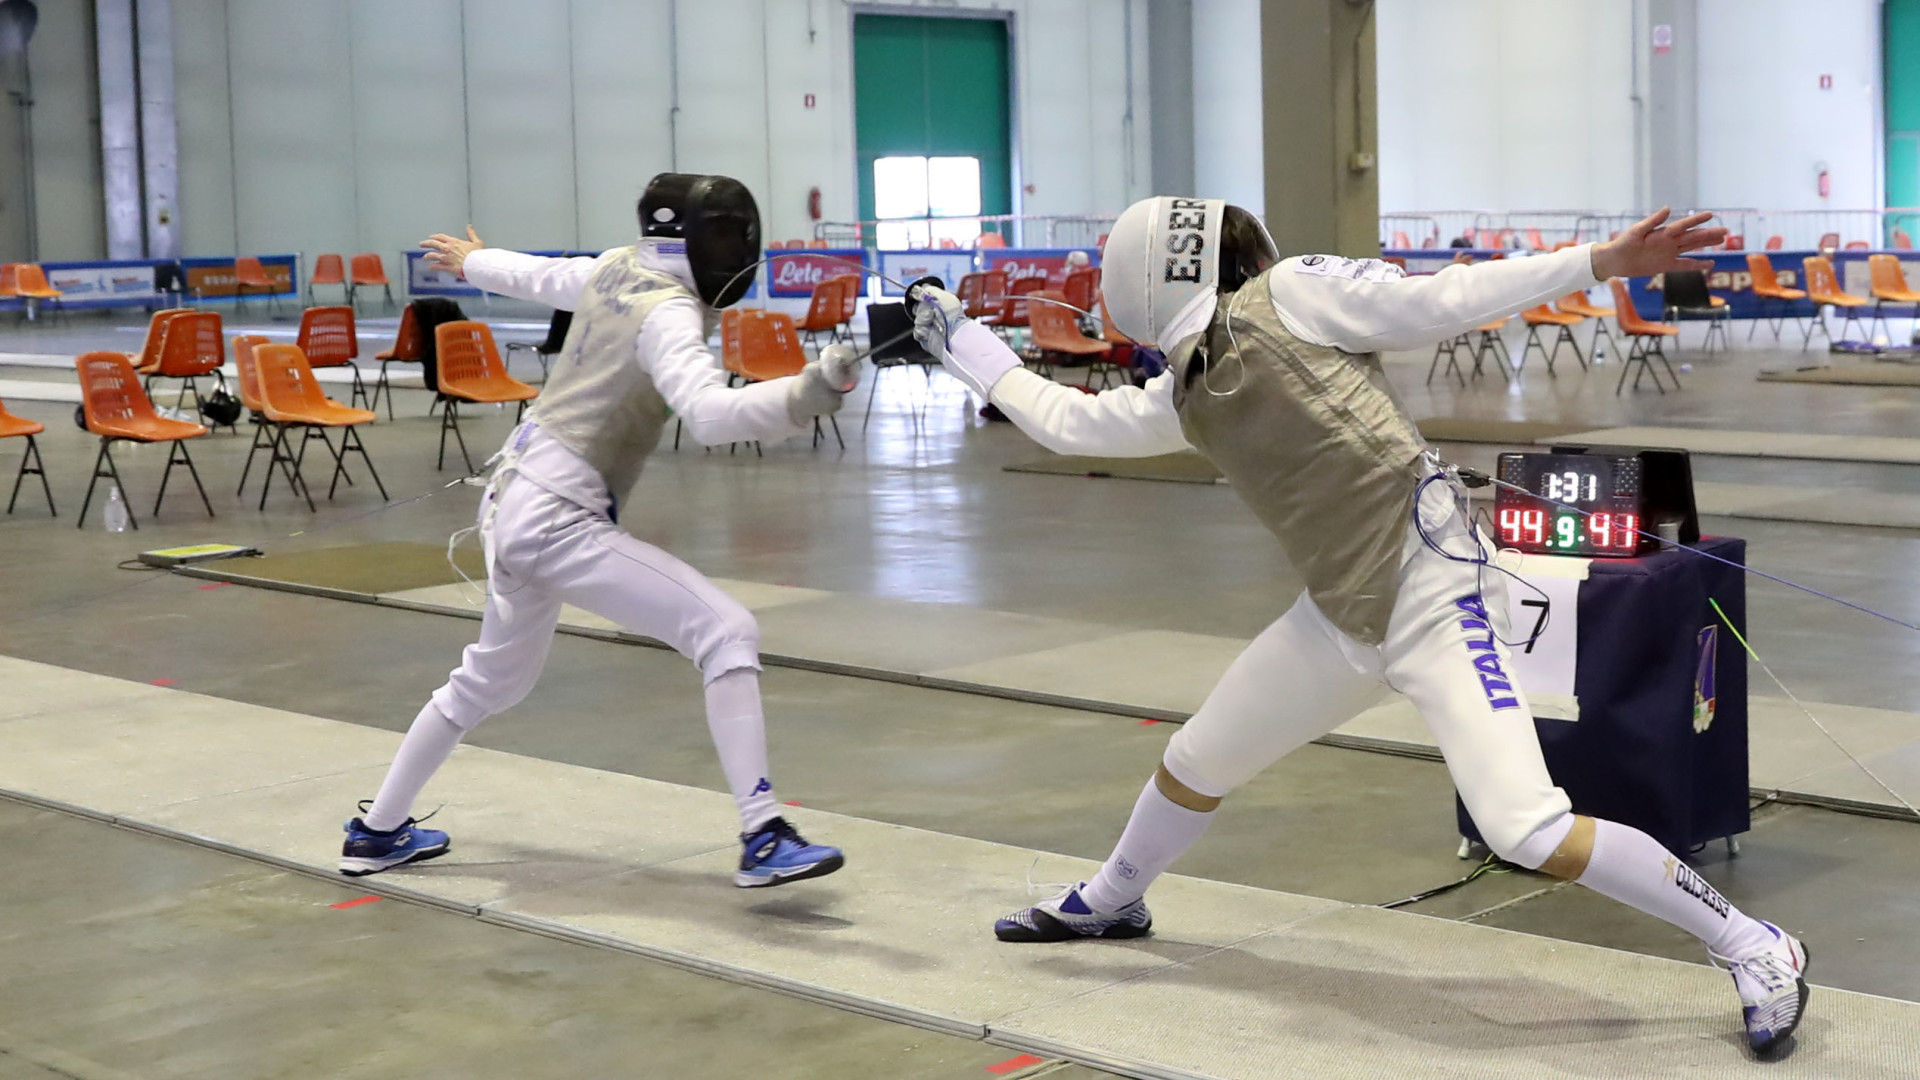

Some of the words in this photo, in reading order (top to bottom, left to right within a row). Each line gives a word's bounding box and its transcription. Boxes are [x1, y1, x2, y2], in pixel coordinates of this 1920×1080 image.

[775, 261, 822, 285] Lete
[1549, 471, 1597, 502] 1:31
[1500, 508, 1544, 544] 44
[1556, 515, 1576, 549] 9
[1589, 512, 1635, 548] 41
[1521, 599, 1549, 654] 7
[1455, 593, 1521, 712] ITALIA
[1676, 863, 1730, 919] ESERCITO
